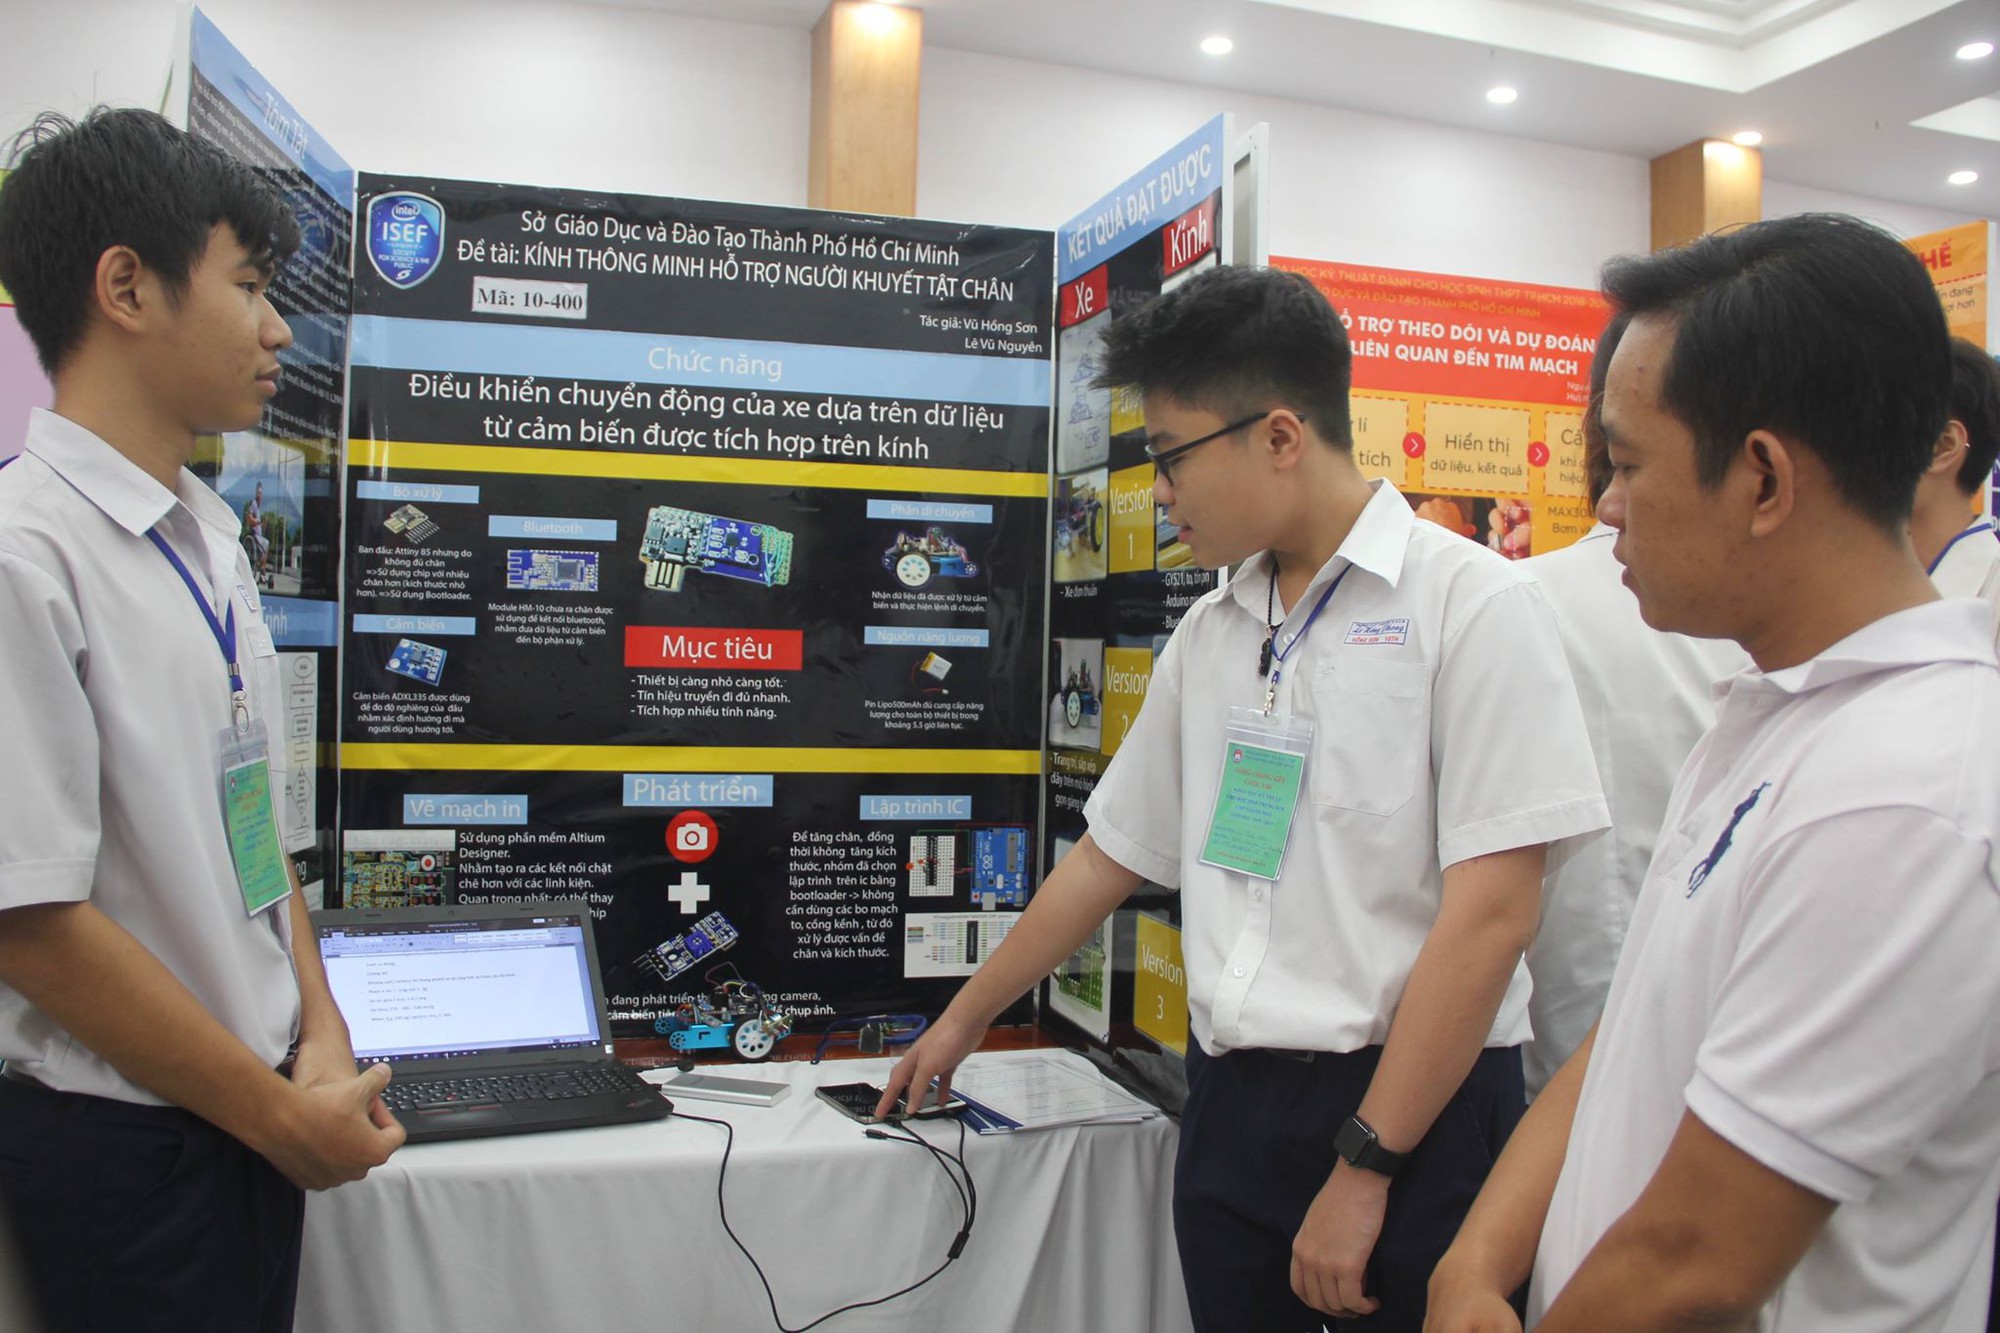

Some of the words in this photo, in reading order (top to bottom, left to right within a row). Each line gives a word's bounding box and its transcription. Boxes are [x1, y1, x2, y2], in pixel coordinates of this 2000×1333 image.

[395, 204, 417, 214] intel
[1068, 222, 1091, 264] KẾT
[1095, 197, 1125, 246] QUẢ
[1127, 179, 1157, 225] ĐẠT
[1160, 144, 1212, 205] ĐƯỢC
[382, 222, 428, 243] ISEF
[521, 211, 546, 232] Sở
[555, 214, 598, 236] Giáo
[604, 217, 641, 243] Dục
[646, 221, 666, 242] và
[672, 223, 710, 245] Đào
[714, 226, 746, 251] Tạo
[750, 229, 806, 253] Thành
[813, 234, 847, 256] Phố
[852, 237, 876, 259] Hồ
[882, 241, 911, 261] Chí
[915, 243, 959, 266] Minh
[1170, 208, 1208, 268] Kính
[457, 239, 485, 262] Đề
[490, 242, 519, 264] tài:
[525, 242, 571, 268] KÍNH
[576, 247, 646, 273] THÔNG
[652, 254, 703, 277] MINH
[710, 253, 738, 280] HỖ
[742, 261, 781, 287] TRỢ
[786, 264, 847, 288] NGƯỜI
[853, 269, 924, 294] KHUYẾT
[927, 273, 958, 300] TẬT
[962, 277, 1013, 301] CHÂN
[479, 288, 514, 306] Mã:
[525, 292, 582, 310] 10-400
[1074, 280, 1094, 319] Xe
[920, 315, 938, 327] Tác
[941, 317, 961, 330] giả:
[963, 318, 978, 329] Vũ
[981, 320, 1012, 335] Hồng
[1016, 322, 1037, 333] Sơn
[1358, 316, 1394, 336] TRỢ
[1398, 320, 1445, 338] THEO
[1451, 324, 1482, 342] DÕI
[1488, 327, 1511, 345] VÀ
[1516, 331, 1542, 350] DỰ
[1545, 334, 1595, 353] ĐOÁN
[965, 338, 978, 349] Lê
[980, 338, 994, 349] Vũ
[998, 340, 1042, 354] Nguyên
[1350, 339, 1389, 358] LIÊN
[1395, 344, 1448, 363] QUAN
[1453, 347, 1489, 367] ĐẾN
[1495, 354, 1524, 370] TIM
[1529, 357, 1577, 375] MẠCH
[648, 346, 712, 374] Chức
[720, 351, 783, 381] năng
[409, 373, 470, 398] Điều
[480, 376, 549, 403] khiển
[559, 382, 650, 413] chuyển
[660, 387, 724, 418] động
[733, 392, 775, 415] của
[782, 401, 810, 417] xe
[817, 397, 861, 424] dựa
[869, 401, 916, 423] trên
[925, 403, 957, 426] dữ
[963, 405, 1003, 432] liệu
[1358, 416, 1368, 433] lí
[484, 415, 512, 438] từ
[518, 416, 571, 441] cảm
[581, 419, 635, 444] biến
[643, 423, 706, 452] được
[713, 427, 758, 450] tích
[768, 429, 815, 458] hợp
[822, 434, 870, 456] trên
[879, 435, 928, 459] kính
[1444, 431, 1484, 452] Hiển
[1488, 436, 1510, 457] thị
[1359, 450, 1391, 467] tích
[1430, 456, 1448, 472] dữ
[1449, 460, 1474, 475] liệu,
[1477, 462, 1495, 475] kết
[1497, 464, 1523, 478] quả
[1110, 483, 1153, 515] Version
[523, 520, 582, 534] Bluetooth
[1128, 533, 1133, 560] 1
[663, 635, 717, 663] Mục
[724, 637, 771, 659] tiêu
[637, 675, 665, 685] Thiết
[668, 676, 678, 687] bị
[682, 676, 708, 688] càng
[711, 676, 733, 686] nhỏ
[736, 677, 762, 689] càng
[765, 677, 783, 687] tốt.
[1106, 664, 1151, 695] Version
[637, 690, 654, 700] Tín
[657, 690, 681, 702] hiệu
[684, 691, 719, 703] truyền
[722, 692, 733, 701] đi
[753, 692, 790, 702] nhanh.
[637, 705, 659, 715] Tích
[663, 705, 685, 718] hợp
[688, 706, 719, 716] nhiều
[722, 707, 743, 716] tính
[746, 708, 776, 719] năng.
[1120, 715, 1129, 741] 2
[633, 778, 692, 802] Phát
[698, 775, 758, 802] triển
[410, 799, 435, 817] Vẽ
[441, 799, 496, 821] mạch
[503, 801, 521, 817] in
[870, 799, 900, 817] Lập
[904, 799, 943, 814] trình
[947, 799, 963, 814] IC
[476, 832, 505, 845] dụng
[569, 832, 605, 842] Altium
[810, 833, 833, 844] tăng
[460, 848, 510, 860] Designer.
[813, 846, 845, 858] không
[1142, 943, 1183, 988] Version
[780, 993, 820, 1001] camera,
[1156, 995, 1164, 1020] 3
[786, 1005, 811, 1018] chụp
